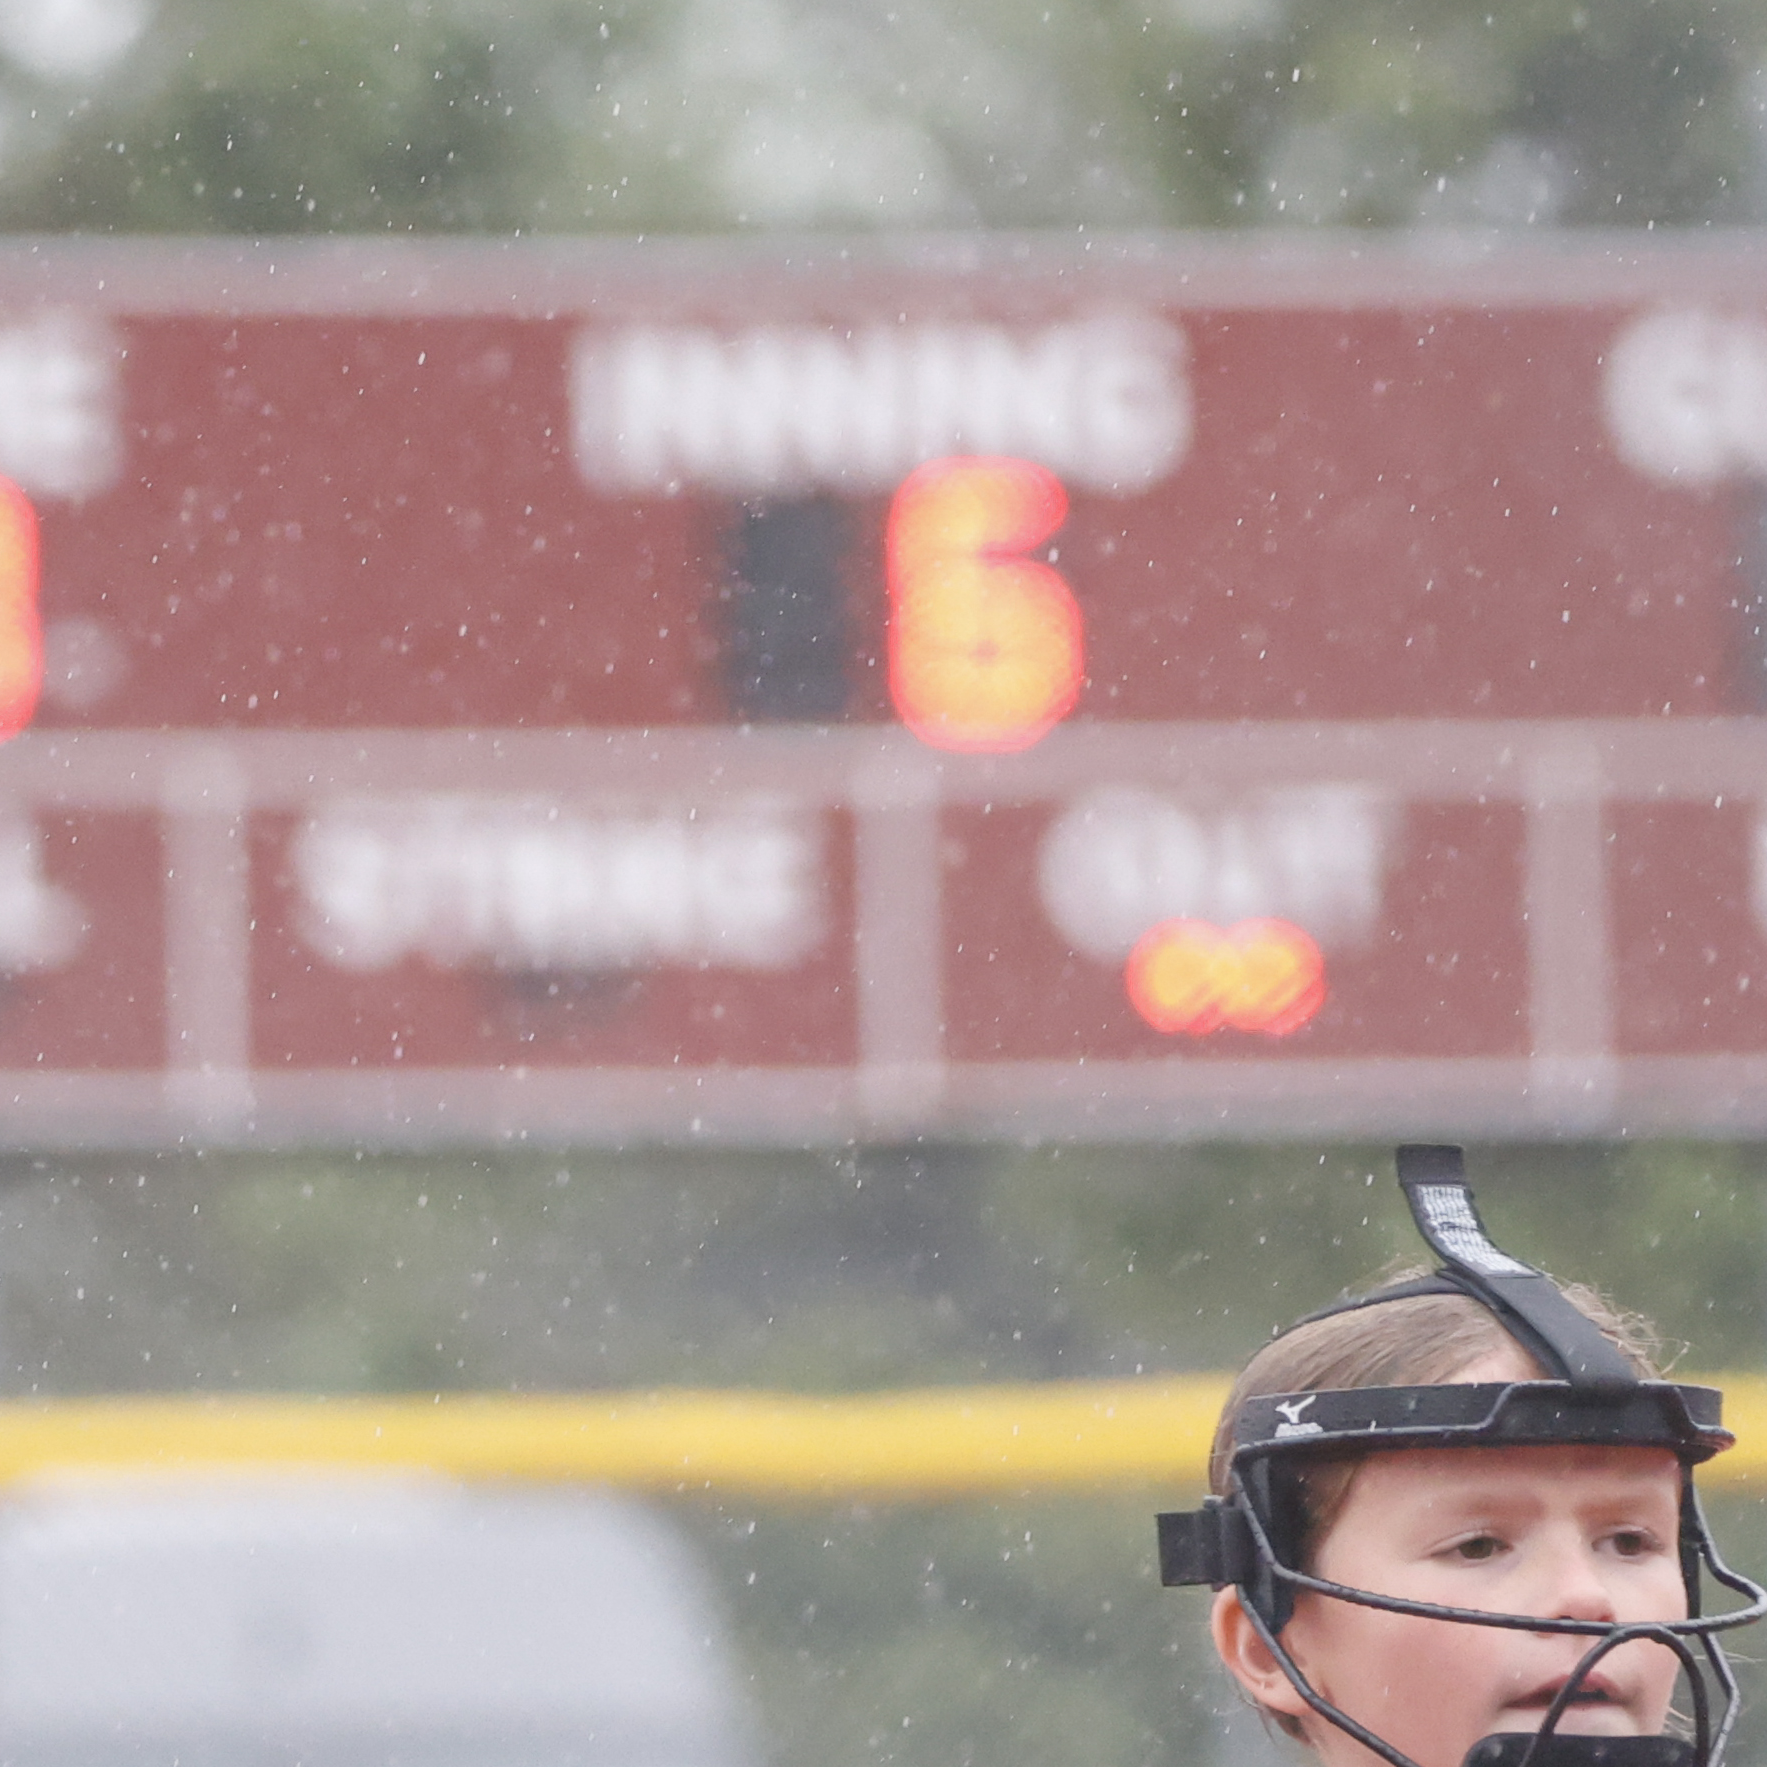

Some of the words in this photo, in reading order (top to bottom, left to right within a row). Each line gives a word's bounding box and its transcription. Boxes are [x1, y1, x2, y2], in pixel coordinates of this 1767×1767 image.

[571, 318, 1189, 494] INNING
[887, 457, 1083, 753] 6
[297, 804, 821, 970] STRIKE
[1041, 792, 1391, 960] OUT
